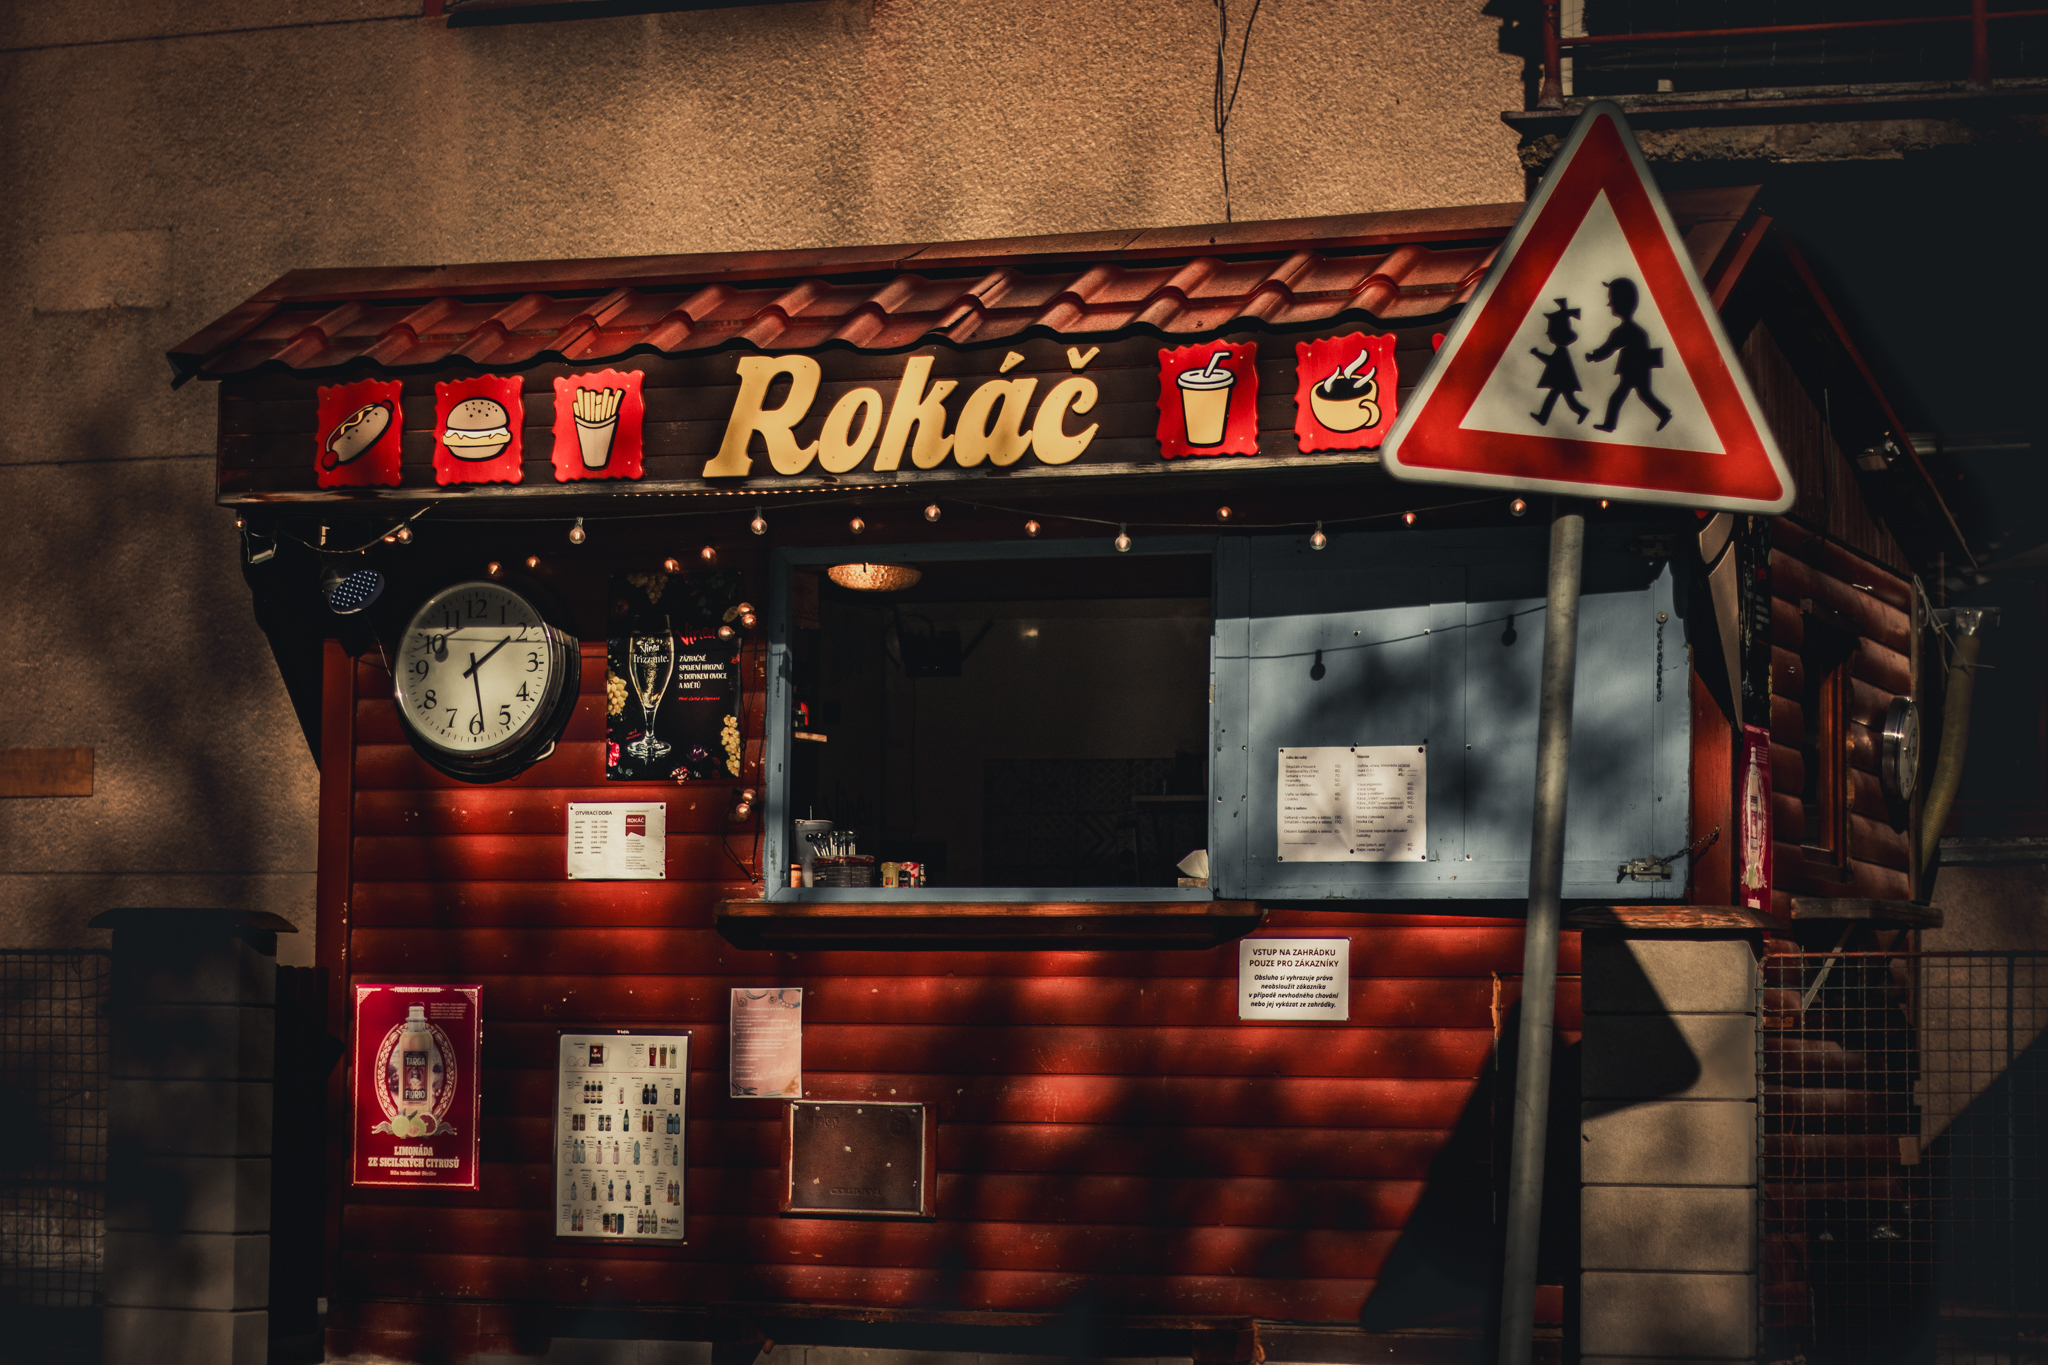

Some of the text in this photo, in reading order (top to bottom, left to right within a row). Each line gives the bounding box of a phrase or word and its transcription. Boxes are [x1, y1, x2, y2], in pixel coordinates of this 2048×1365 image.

[702, 346, 1100, 478] Rokáč
[466, 599, 488, 620] 12
[500, 605, 507, 625] 1
[443, 610, 460, 630] 11
[515, 622, 528, 642] 2
[675, 622, 716, 646] Vinea
[424, 634, 446, 655] 10
[639, 642, 660, 655] Vinea
[526, 652, 539, 672] 3
[678, 662, 725, 671] SPOJENÍ HROZNŮ
[679, 653, 707, 662] ZÁZRAČNÉ
[416, 660, 430, 683] 9
[709, 672, 728, 680] OVOCE
[516, 681, 529, 702] 4
[683, 680, 702, 689] KVĚTŮ
[424, 689, 437, 710] 8
[445, 708, 458, 728] 7
[469, 713, 482, 735] 6
[498, 704, 511, 726] 5
[1252, 947, 1336, 956] VSTUP NA ZAHRÁDKU
[1249, 958, 1339, 968] POUZE PRO ZÁKAZNÍKY
[1307, 1001, 1337, 1009] zahrádky.
[406, 1057, 426, 1066] TARGA
[405, 1090, 426, 1100] FLORIO
[394, 1144, 434, 1156] LIMONÁDA
[367, 1155, 460, 1169] ZE SICILSKÝCH CITRUSŮ
